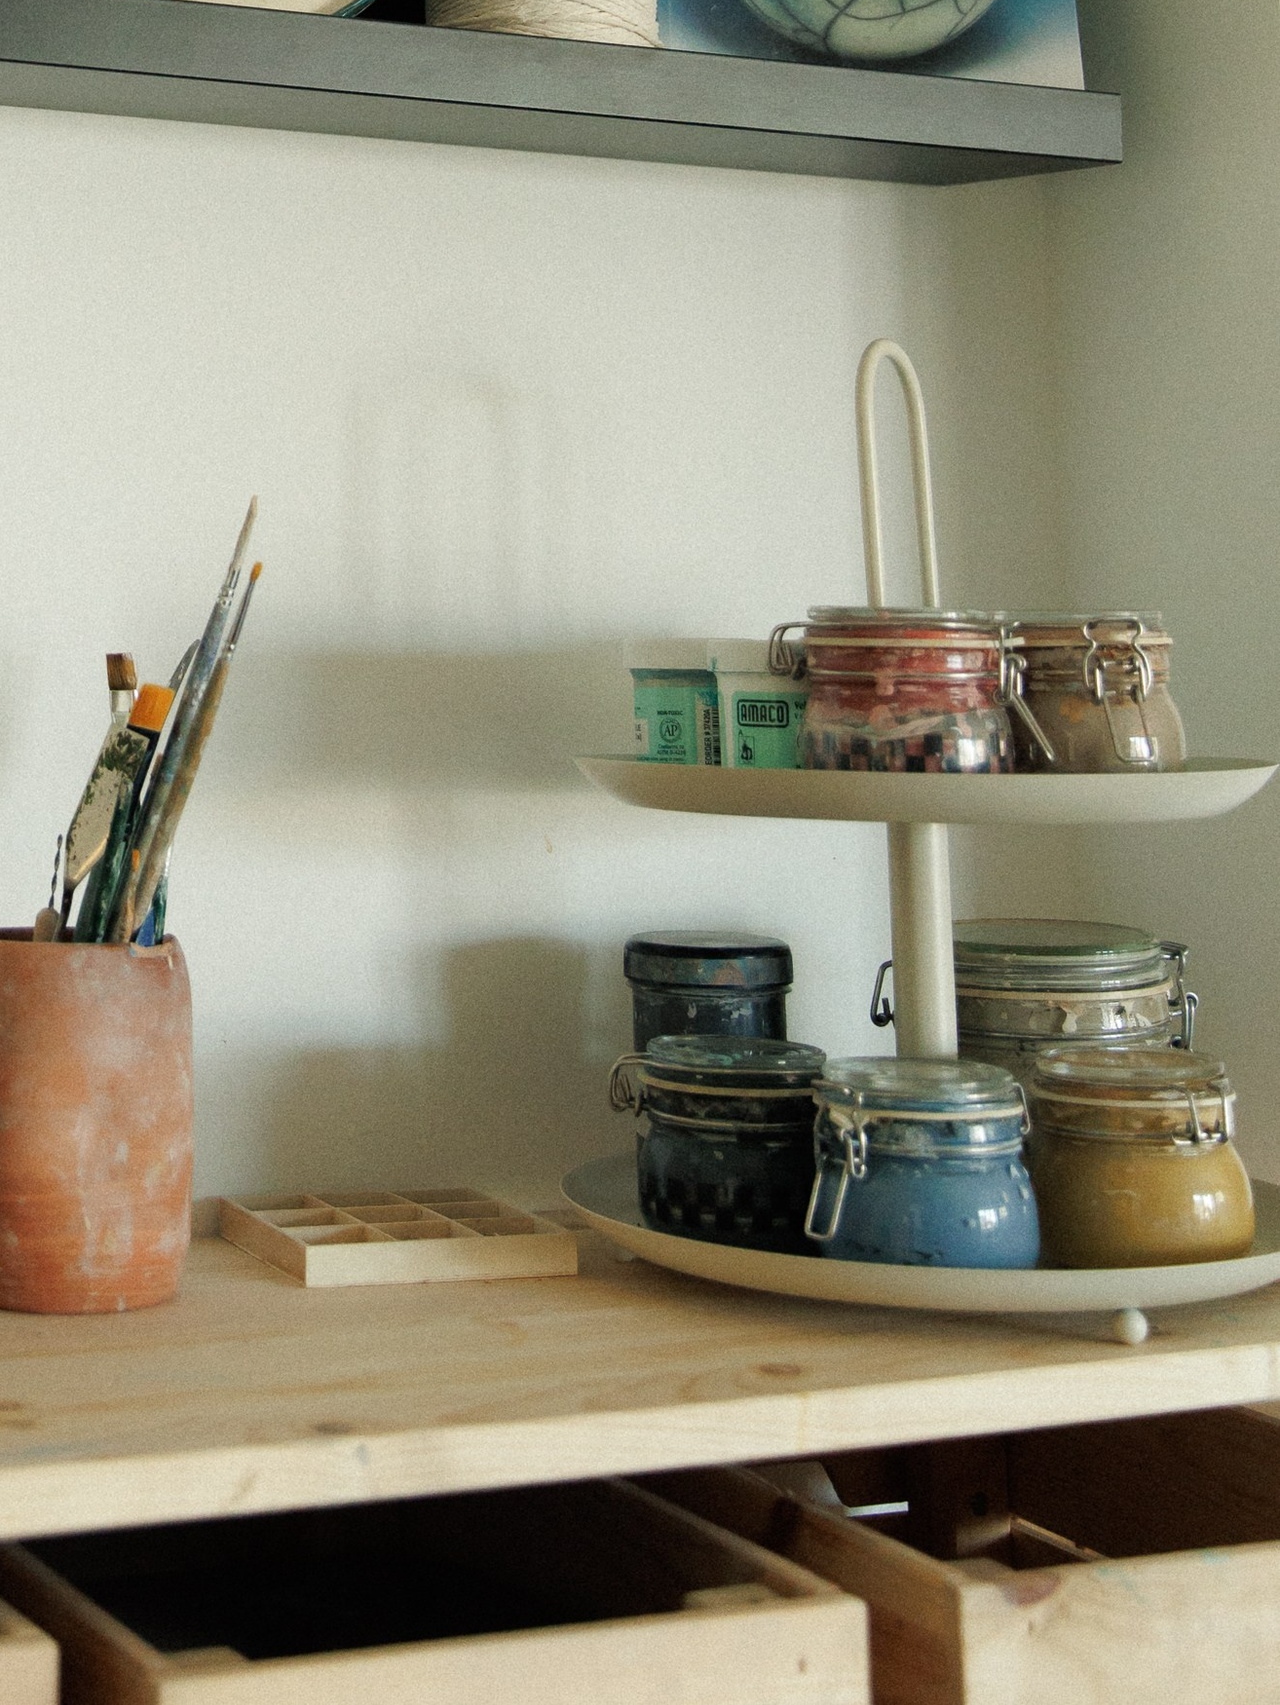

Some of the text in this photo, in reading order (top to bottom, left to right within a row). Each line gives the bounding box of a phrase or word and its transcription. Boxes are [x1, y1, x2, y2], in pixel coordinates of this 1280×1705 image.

[740, 704, 785, 723] AMACO
[664, 725, 678, 737] AP
[703, 737, 713, 765] EORDER
